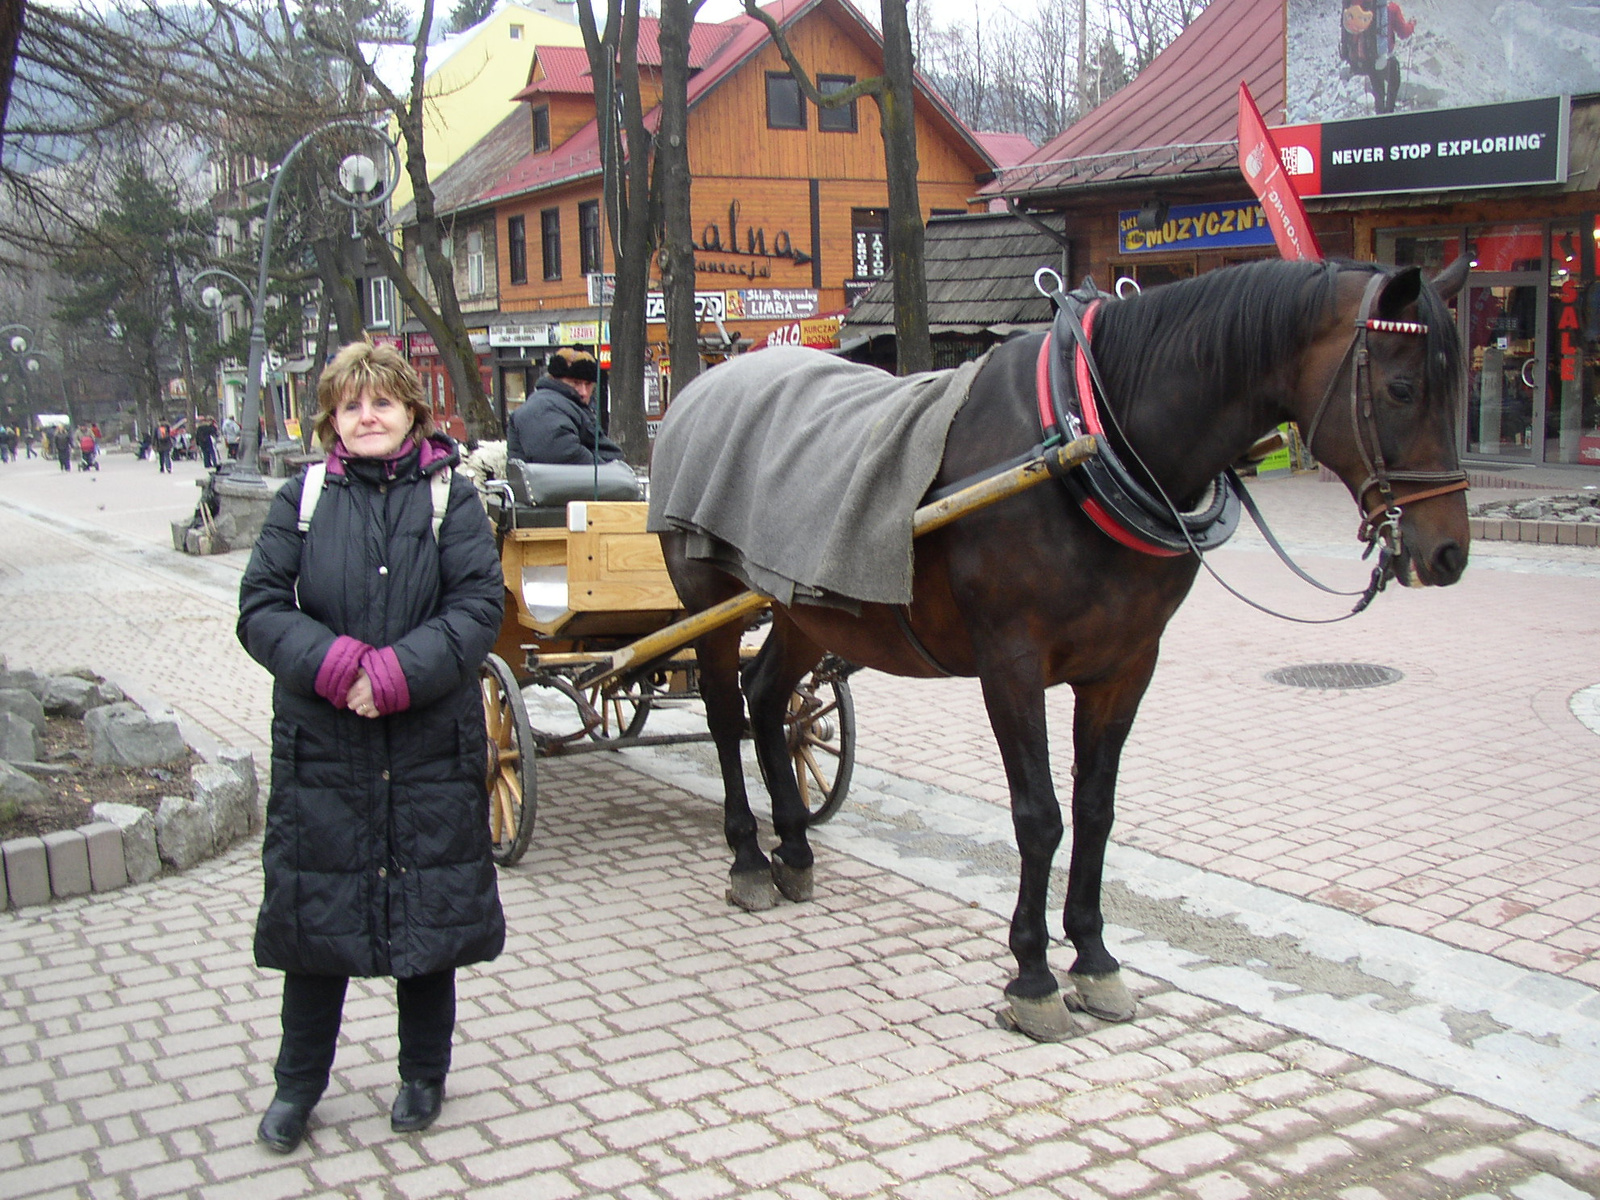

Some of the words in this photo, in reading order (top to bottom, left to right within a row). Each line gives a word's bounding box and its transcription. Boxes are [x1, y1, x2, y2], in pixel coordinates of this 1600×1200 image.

[1281, 146, 1298, 157] THE
[1332, 147, 1384, 165] NEVER
[1390, 143, 1431, 161] STOP
[692, 199, 796, 259] alna
[1121, 217, 1138, 231] SKL
[1146, 206, 1267, 248] MUZYCZNY
[872, 233, 884, 276] TATTOO
[747, 289, 771, 303] Sklep
[773, 289, 818, 303] Regionalny
[752, 301, 793, 314] LIMBA
[1559, 279, 1580, 381] SALE
